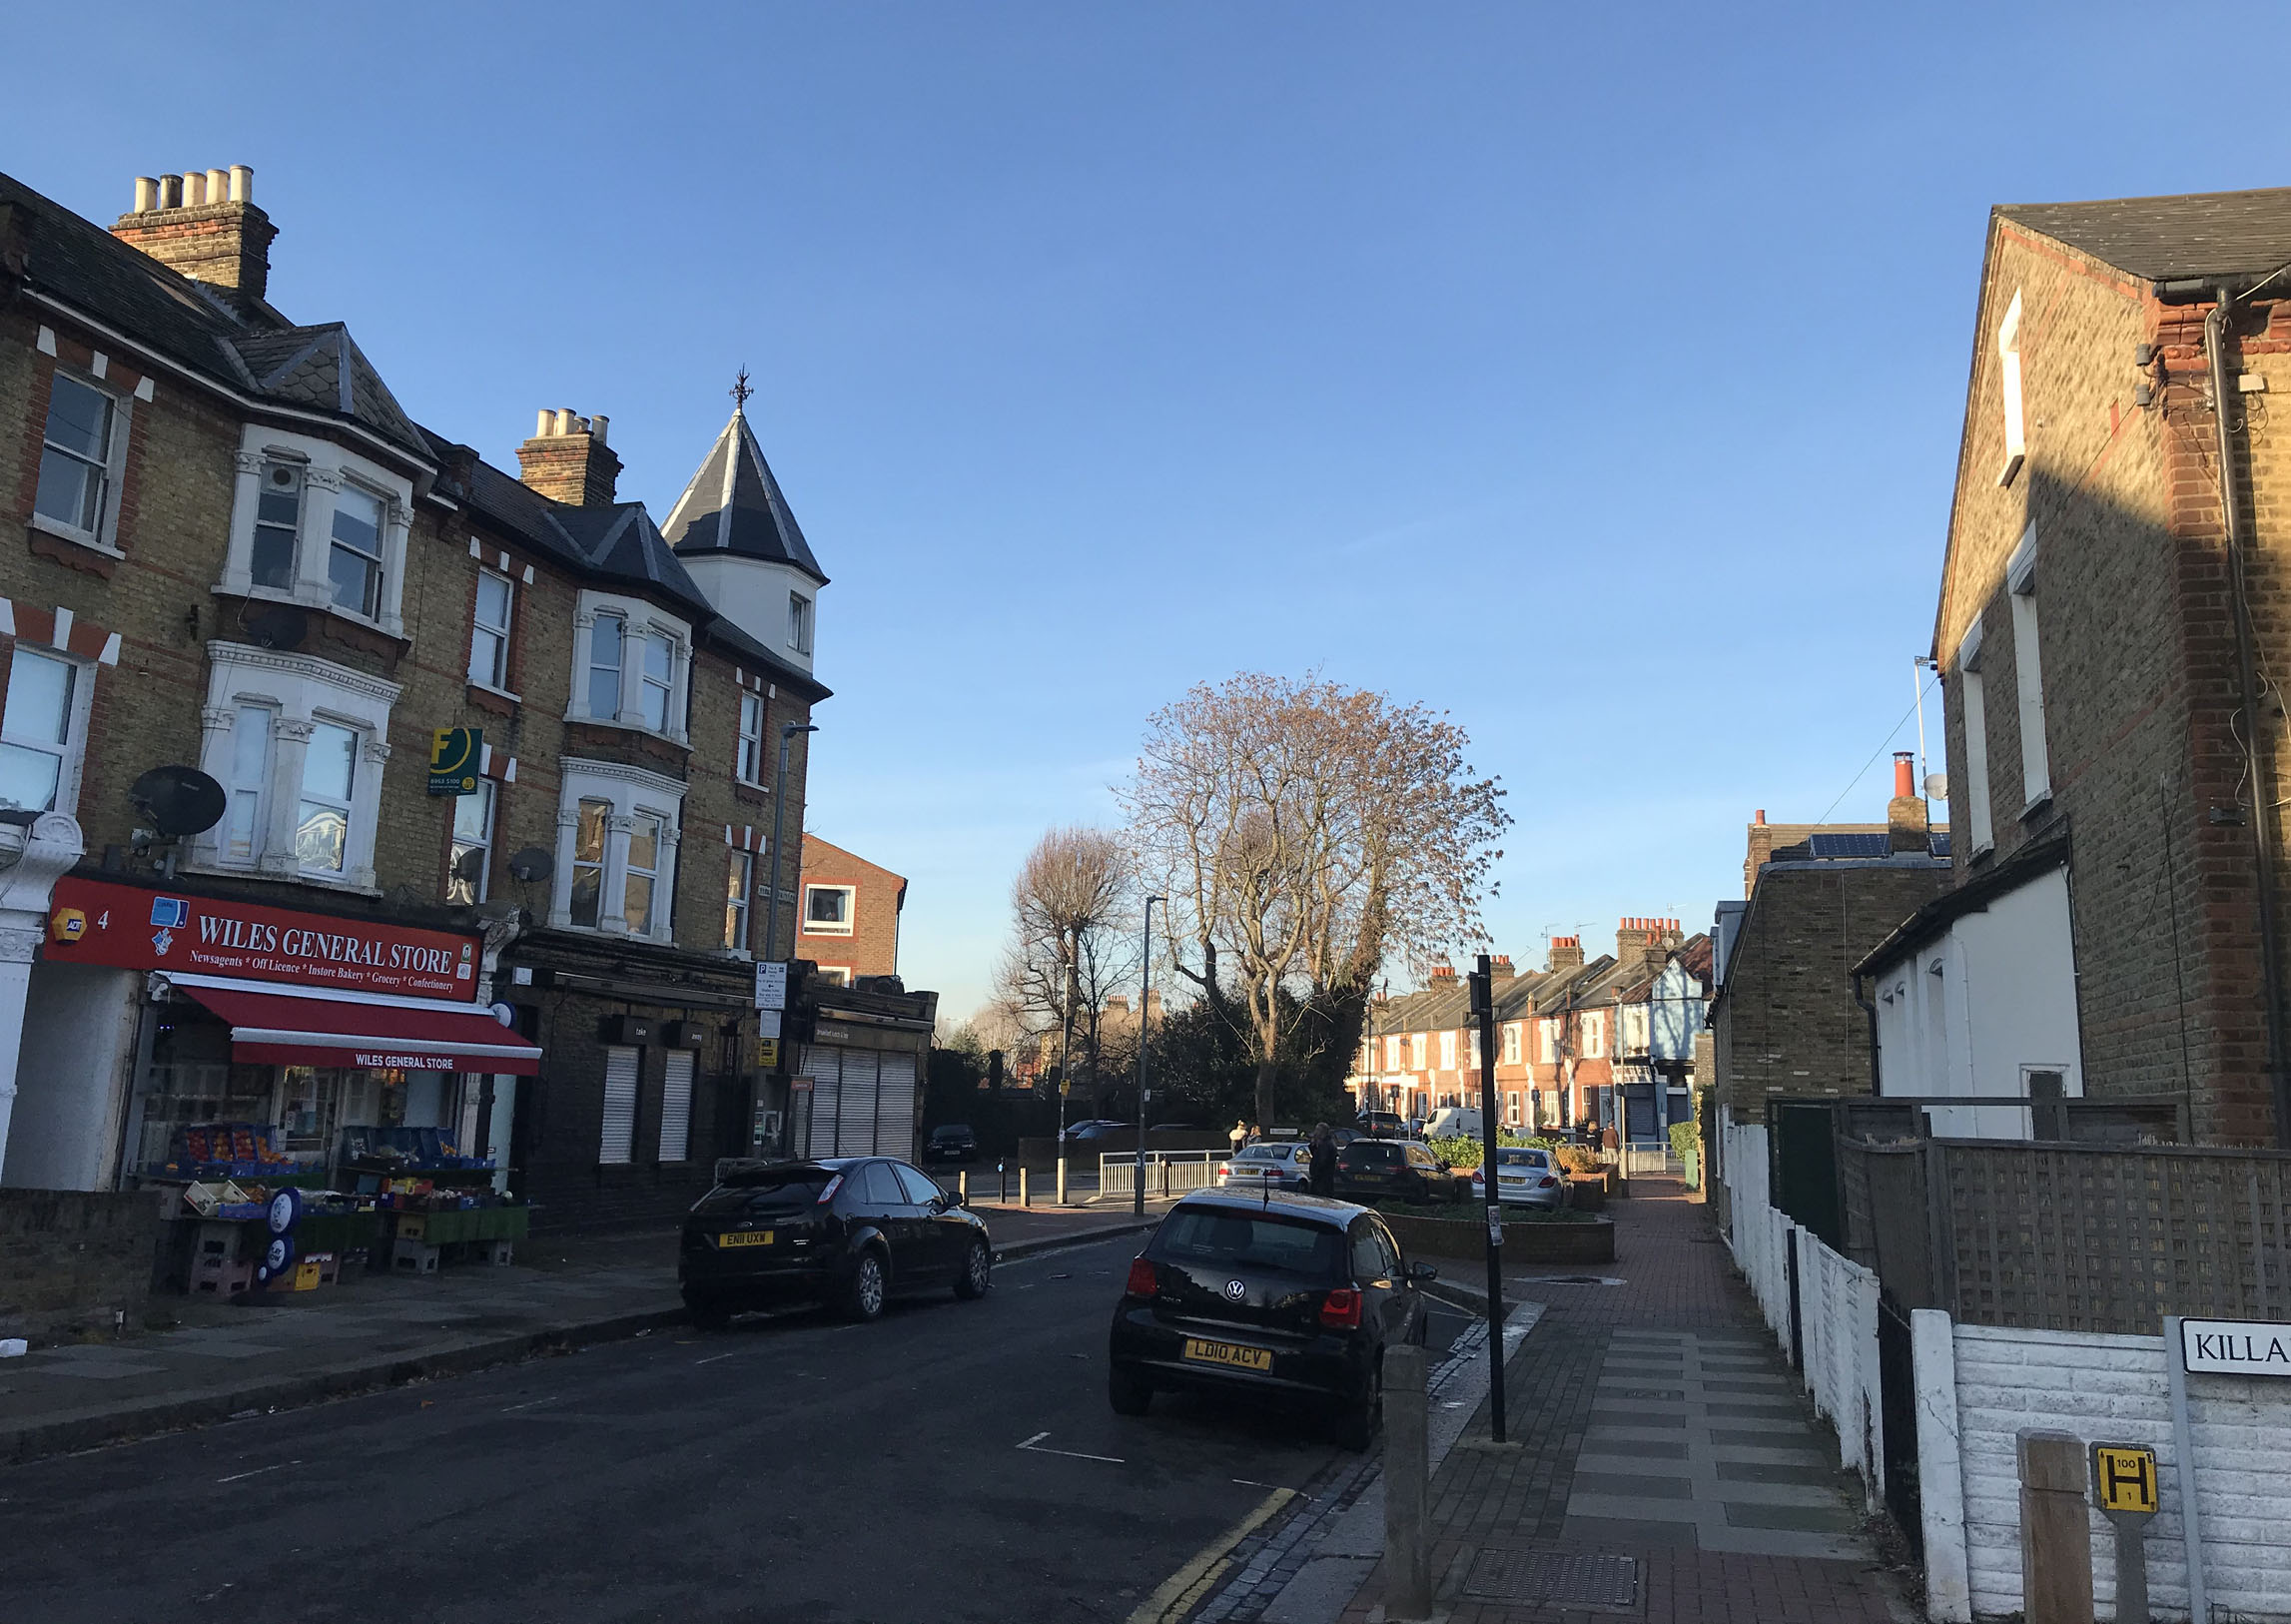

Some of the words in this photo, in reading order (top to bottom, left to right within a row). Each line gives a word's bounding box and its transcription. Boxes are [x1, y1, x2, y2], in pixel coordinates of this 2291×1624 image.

[67, 920, 82, 931] ADT
[97, 910, 109, 930] 4
[200, 915, 278, 953] WILES
[283, 928, 386, 967] GENERAL
[388, 943, 452, 975] STORE
[190, 949, 243, 968] Newsagents
[252, 957, 268, 970] Off
[269, 959, 301, 974] Licence
[308, 963, 337, 978] Instore
[337, 967, 365, 984] Bakery
[372, 971, 401, 988] Grocery
[407, 976, 453, 994] Confectionery
[356, 1053, 383, 1067] WILES
[384, 1055, 425, 1069] GENERAL
[426, 1057, 453, 1070] STORE
[1194, 1340, 1228, 1360] LD10
[1231, 1347, 1262, 1365] ACV
[2195, 1333, 2291, 1363] KILLA
[2116, 1459, 2136, 1468] 100
[2106, 1454, 2149, 1505] H
[2127, 1491, 2132, 1500] 1
